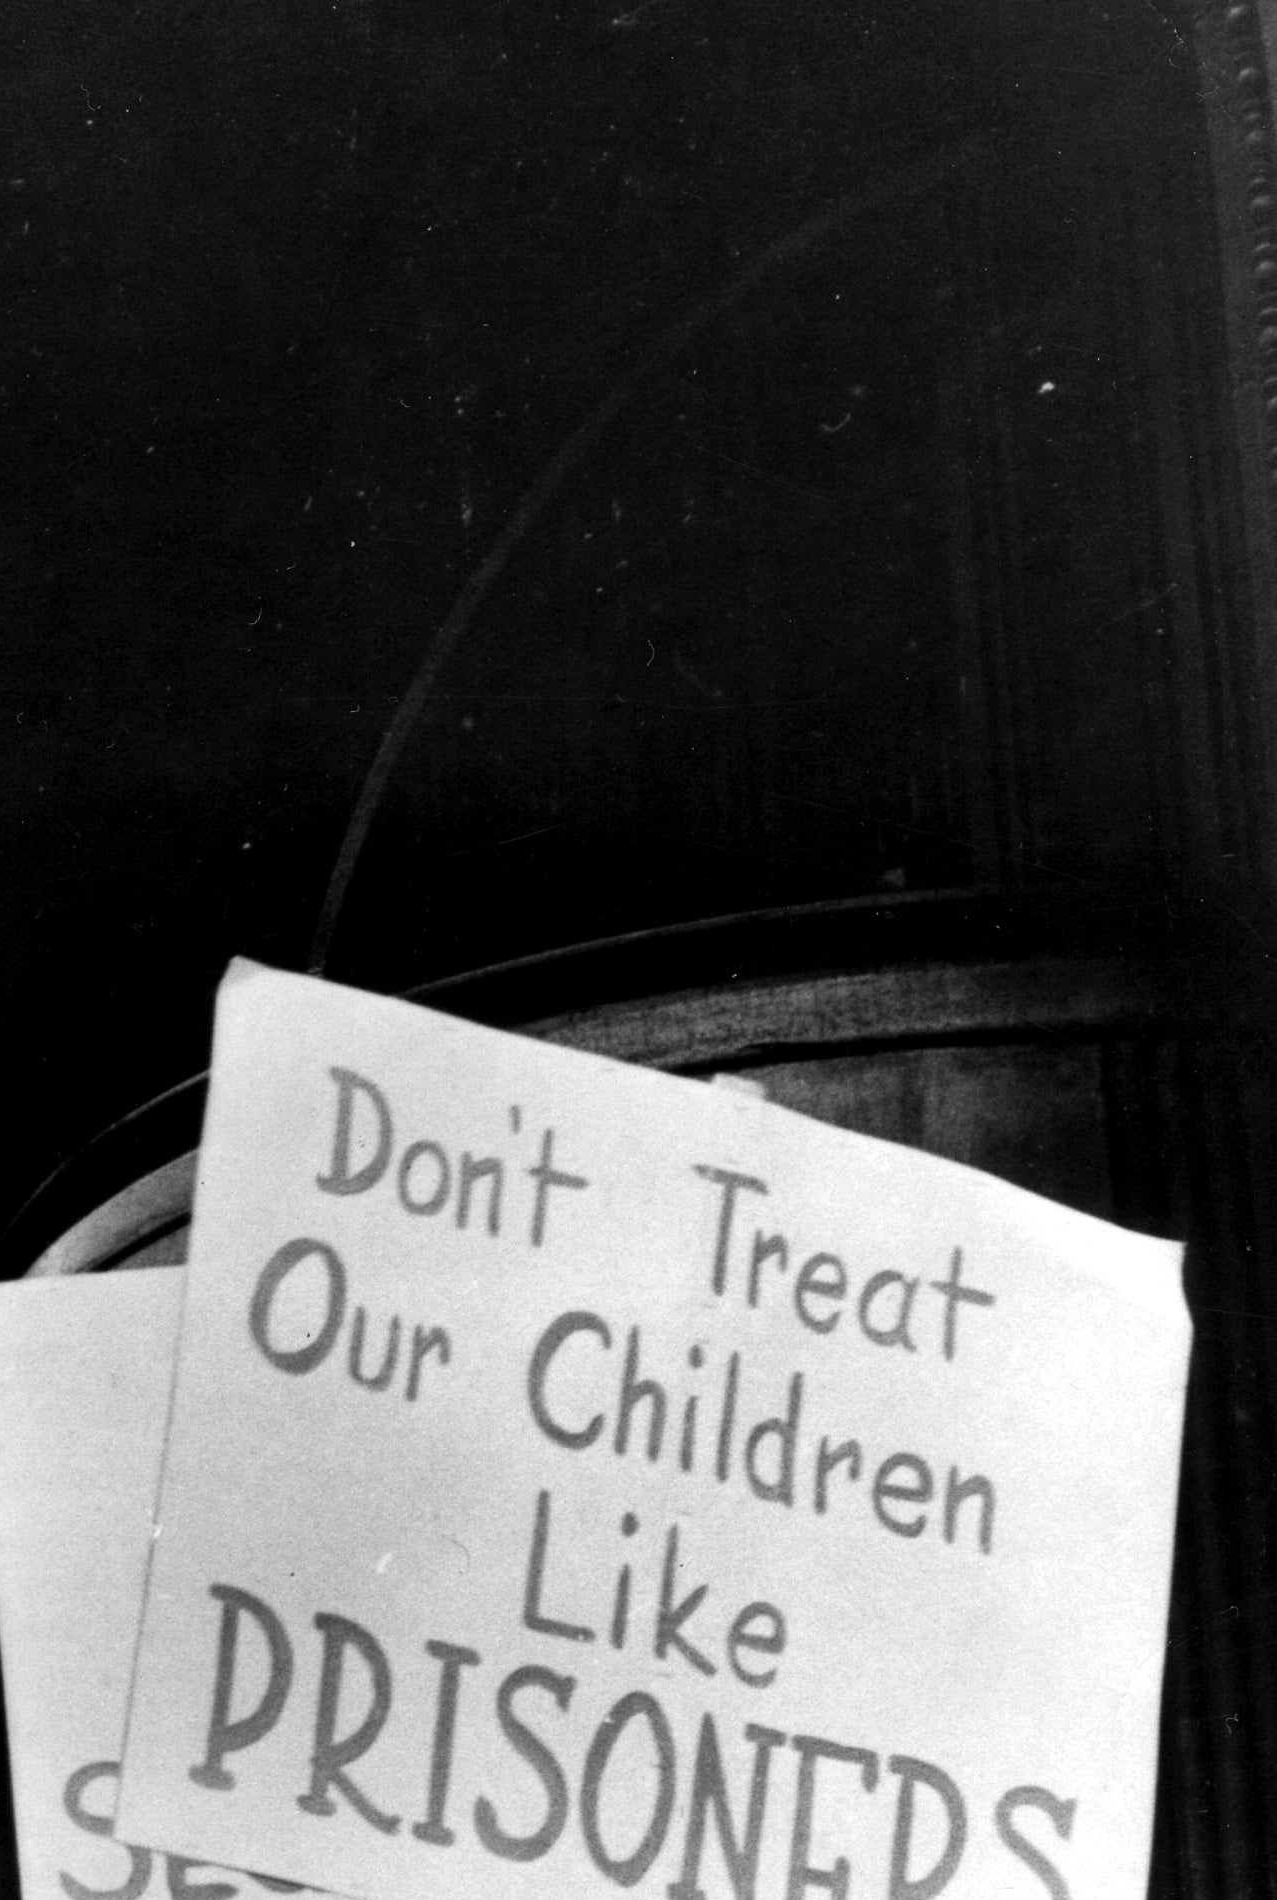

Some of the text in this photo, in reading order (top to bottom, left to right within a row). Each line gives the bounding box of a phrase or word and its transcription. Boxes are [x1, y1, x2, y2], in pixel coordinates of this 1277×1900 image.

[315, 1066, 996, 1361] Don't Treat
[247, 1236, 998, 1556] Our Children
[519, 1487, 788, 1690] Like
